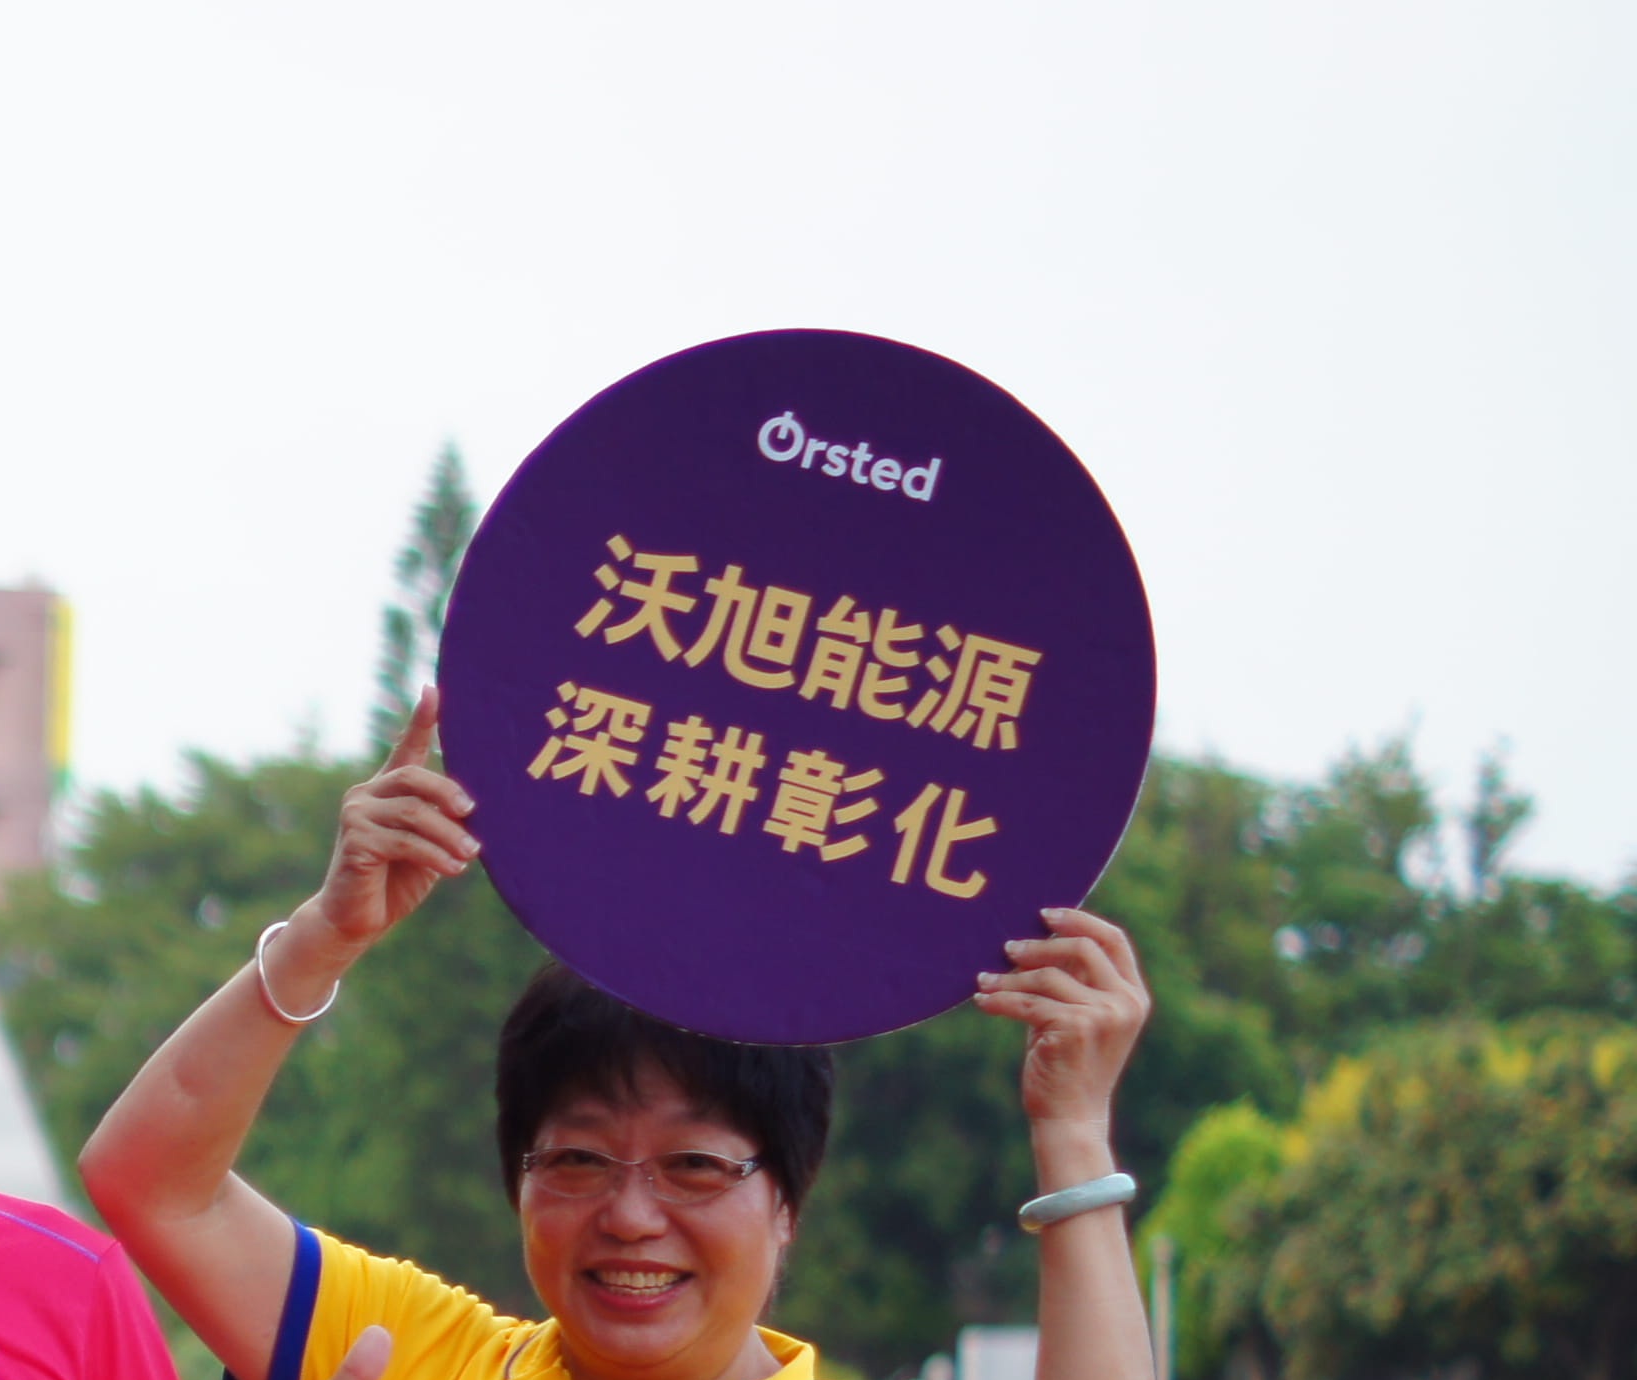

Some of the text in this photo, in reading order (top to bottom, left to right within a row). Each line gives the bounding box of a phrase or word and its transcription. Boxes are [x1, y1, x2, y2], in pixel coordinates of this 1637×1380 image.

[574, 534, 1042, 752] 沃旭能源
[527, 680, 998, 900] 深耕彰化
